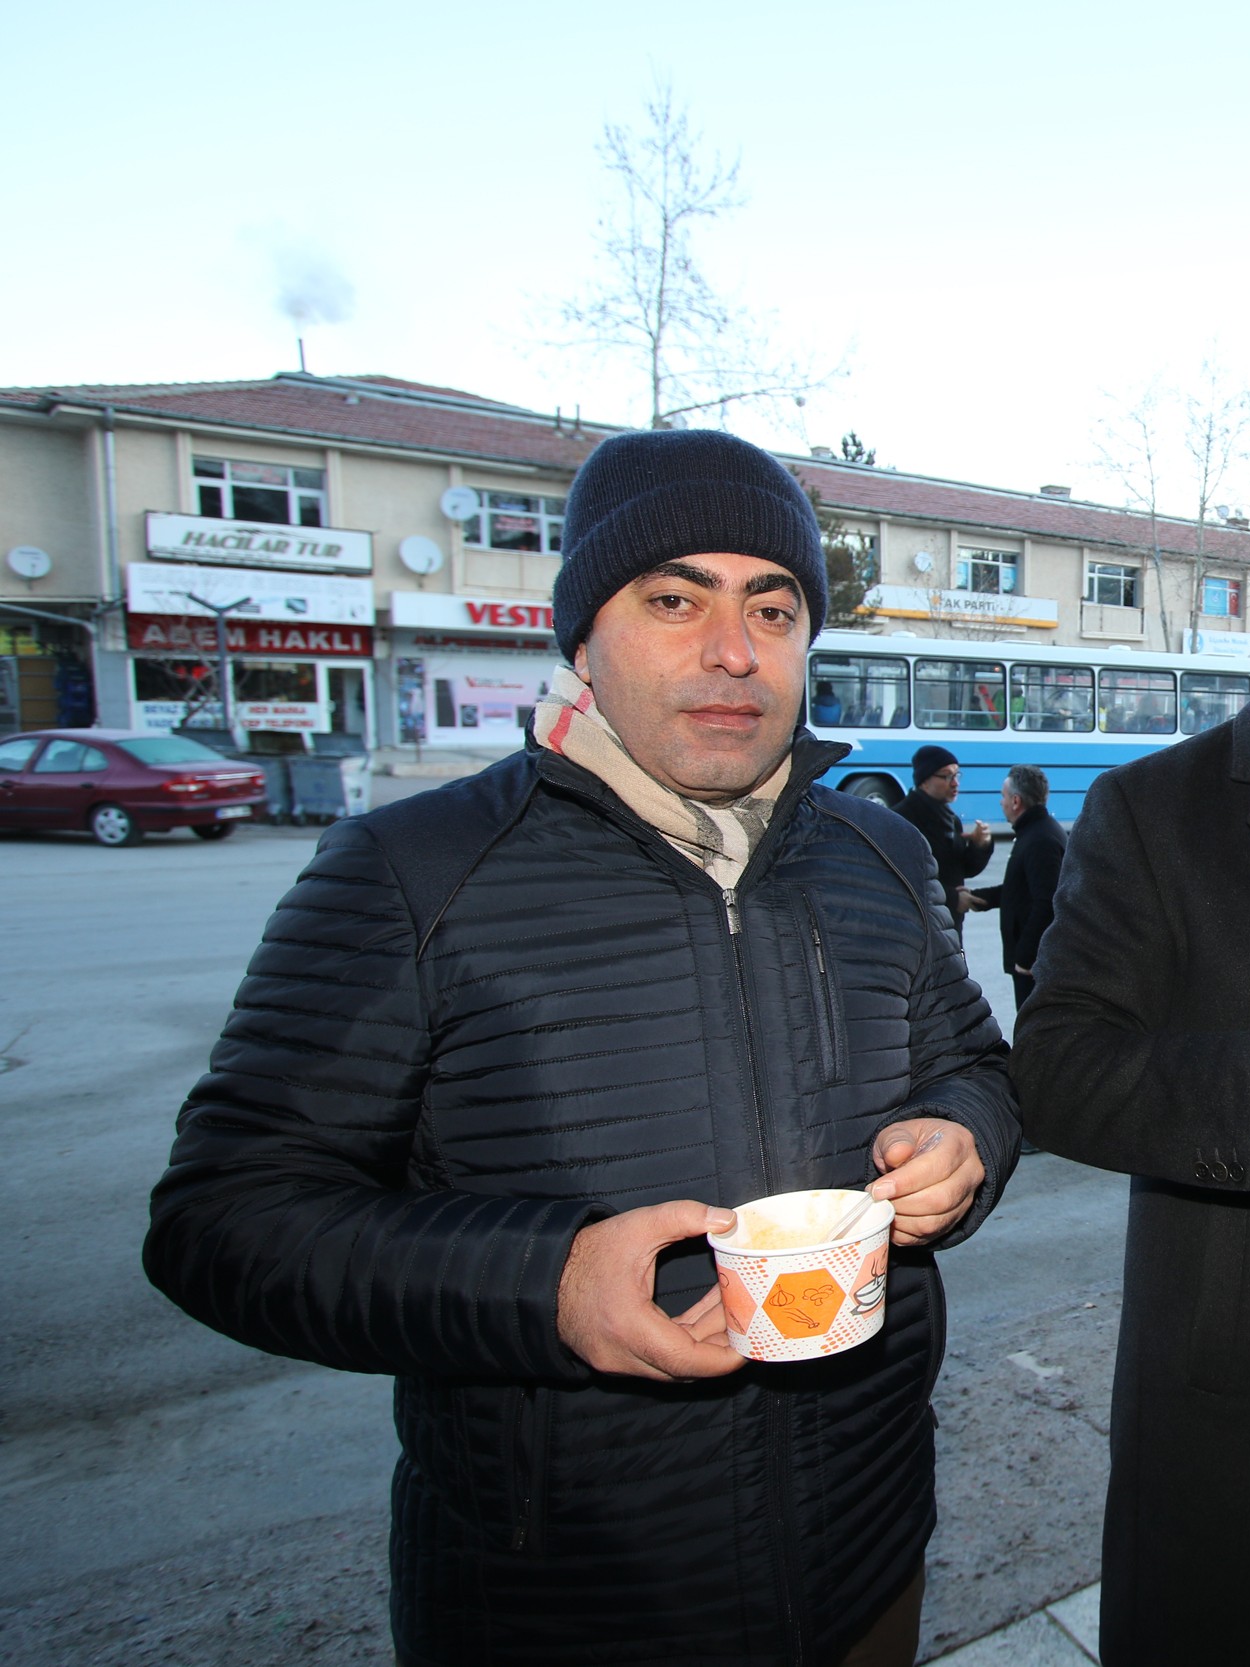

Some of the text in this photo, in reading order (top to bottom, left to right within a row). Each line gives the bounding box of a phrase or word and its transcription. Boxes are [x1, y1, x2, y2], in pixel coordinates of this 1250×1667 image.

[181, 530, 291, 555] HACILAR
[297, 540, 343, 559] TUR
[943, 598, 961, 609] AK
[259, 628, 362, 651] HAKLI
